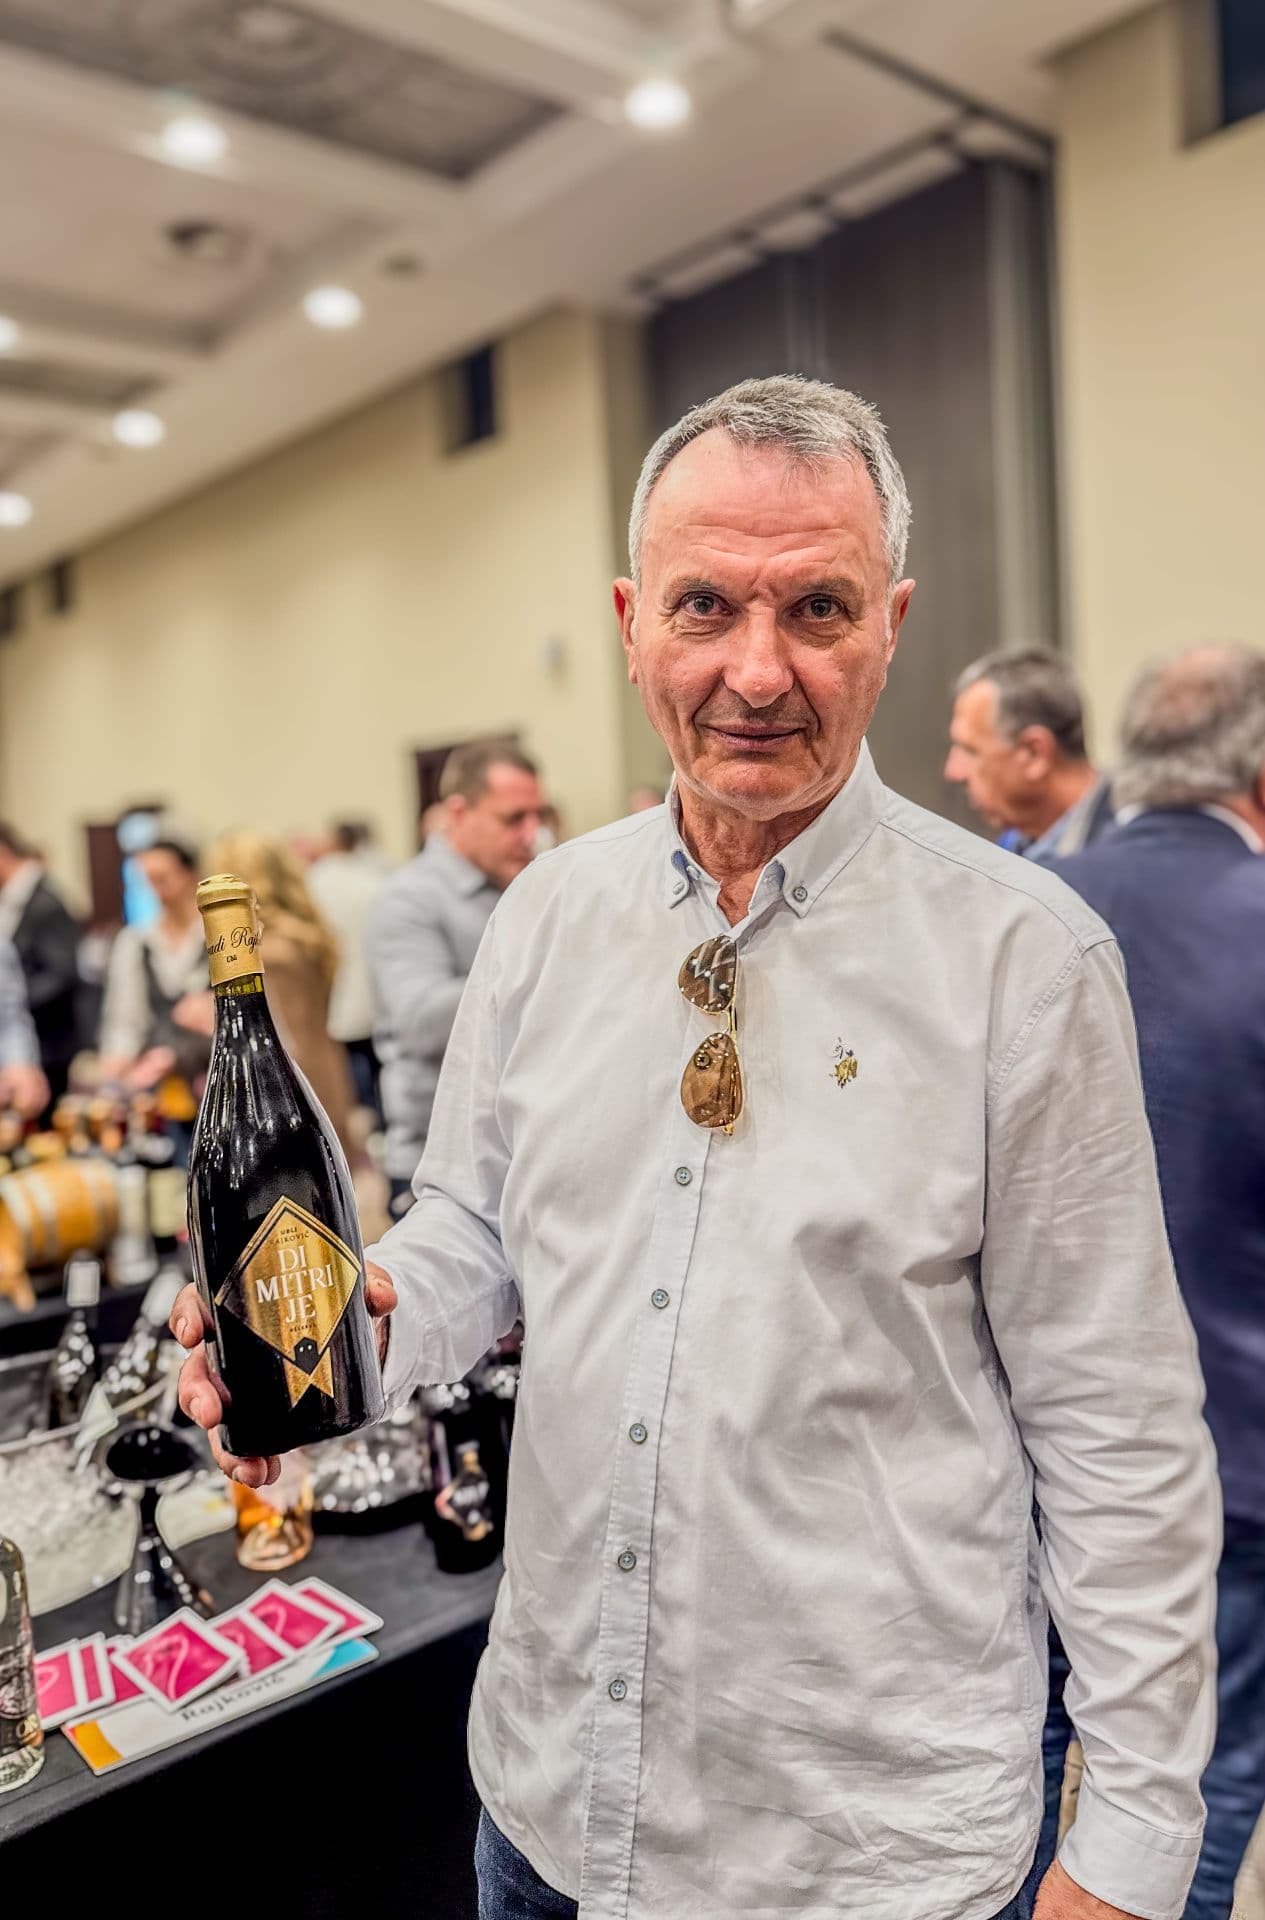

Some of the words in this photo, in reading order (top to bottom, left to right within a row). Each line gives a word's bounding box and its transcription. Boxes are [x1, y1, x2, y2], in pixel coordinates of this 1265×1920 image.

[278, 1245, 306, 1273] DI
[255, 1264, 334, 1303] MITRI
[285, 1294, 316, 1324] JE
